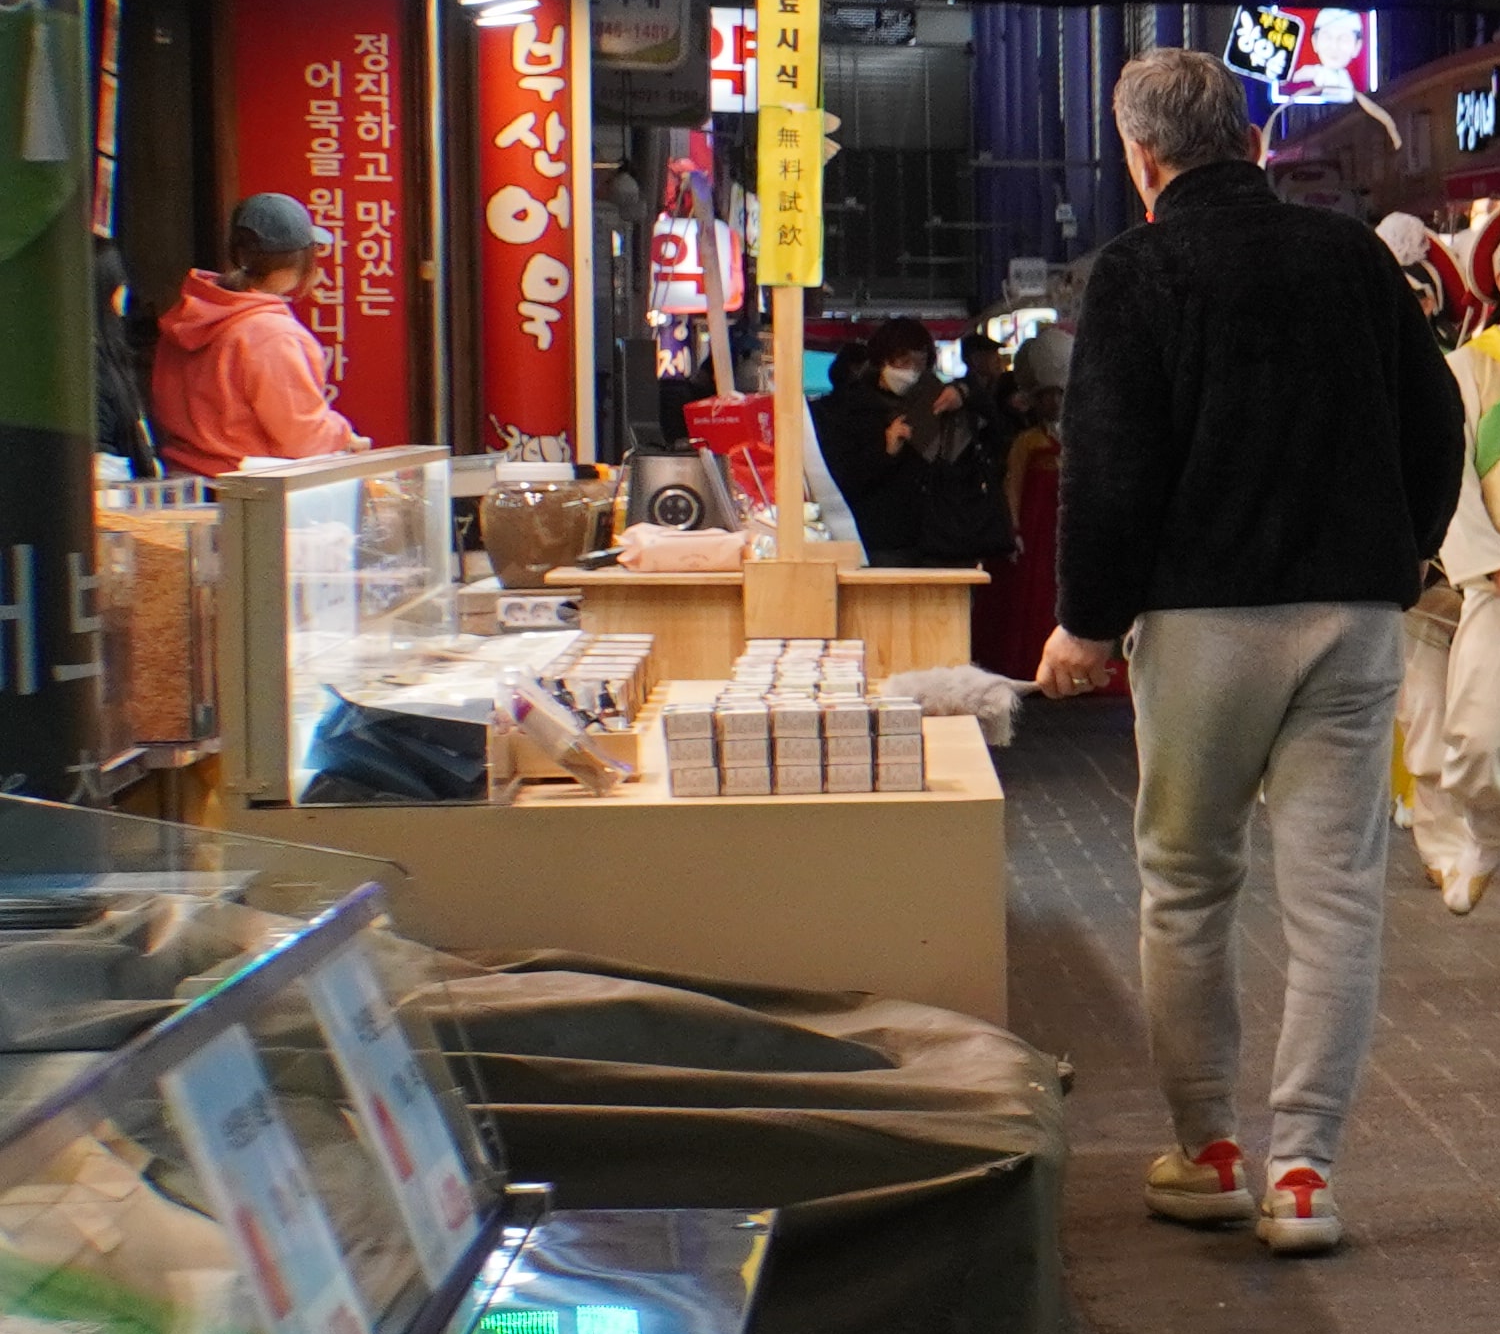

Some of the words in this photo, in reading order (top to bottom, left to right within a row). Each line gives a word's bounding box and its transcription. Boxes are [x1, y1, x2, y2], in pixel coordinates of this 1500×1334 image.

[304, 59, 347, 178] 어묵을
[353, 33, 396, 183] 정직하고
[485, 22, 571, 352] 부산어묵
[354, 199, 396, 317] 맛있는
